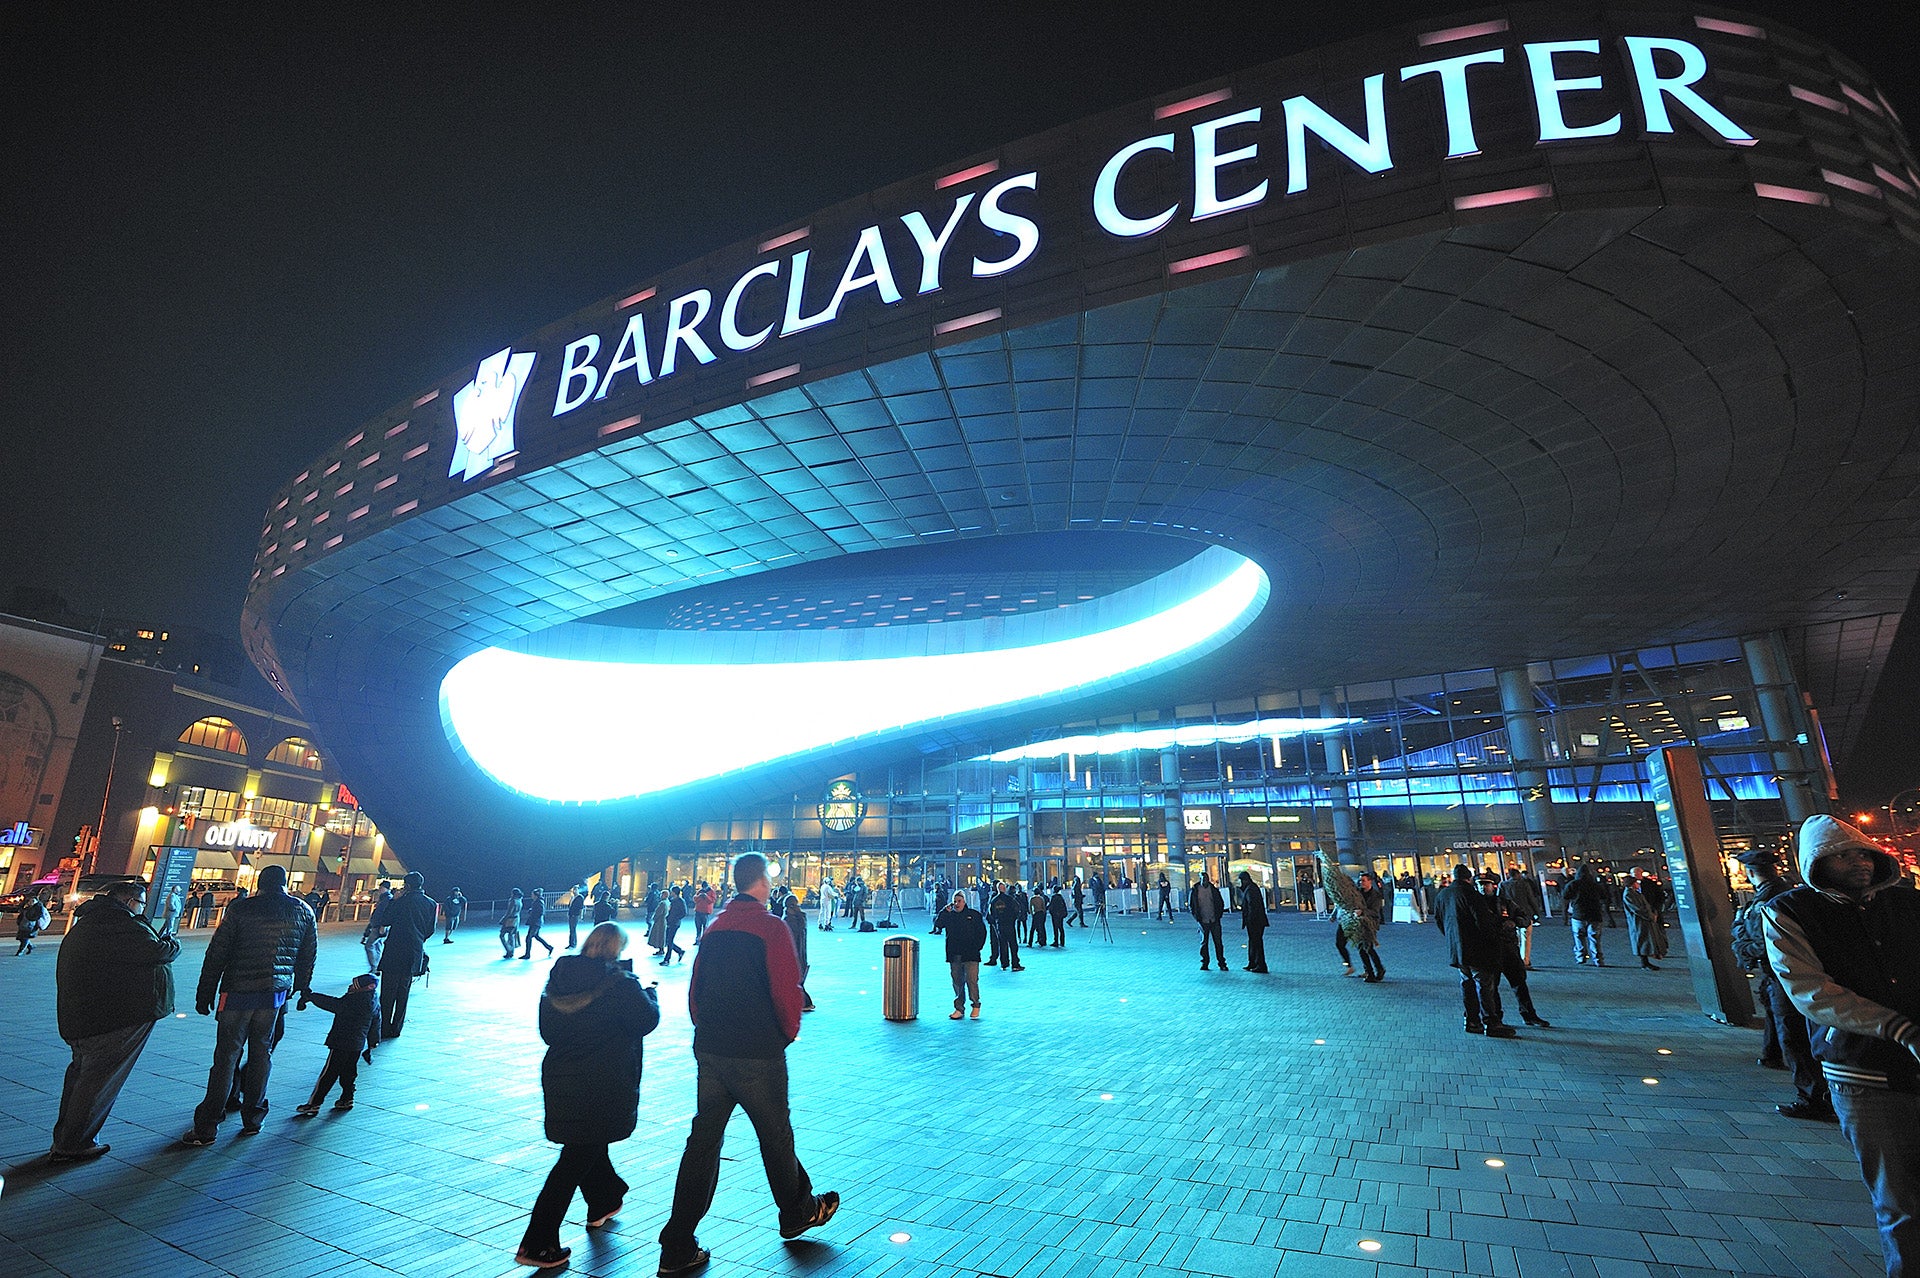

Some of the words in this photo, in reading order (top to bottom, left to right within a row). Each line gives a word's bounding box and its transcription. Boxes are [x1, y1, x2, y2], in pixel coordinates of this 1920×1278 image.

[552, 171, 1039, 417] BARCLAYS
[1093, 36, 1757, 238] CENTER
[205, 825, 238, 846] OLD
[237, 829, 277, 850] NAVY
[1453, 841, 1477, 849] GEICO
[1500, 839, 1545, 848] ENTRANCE
